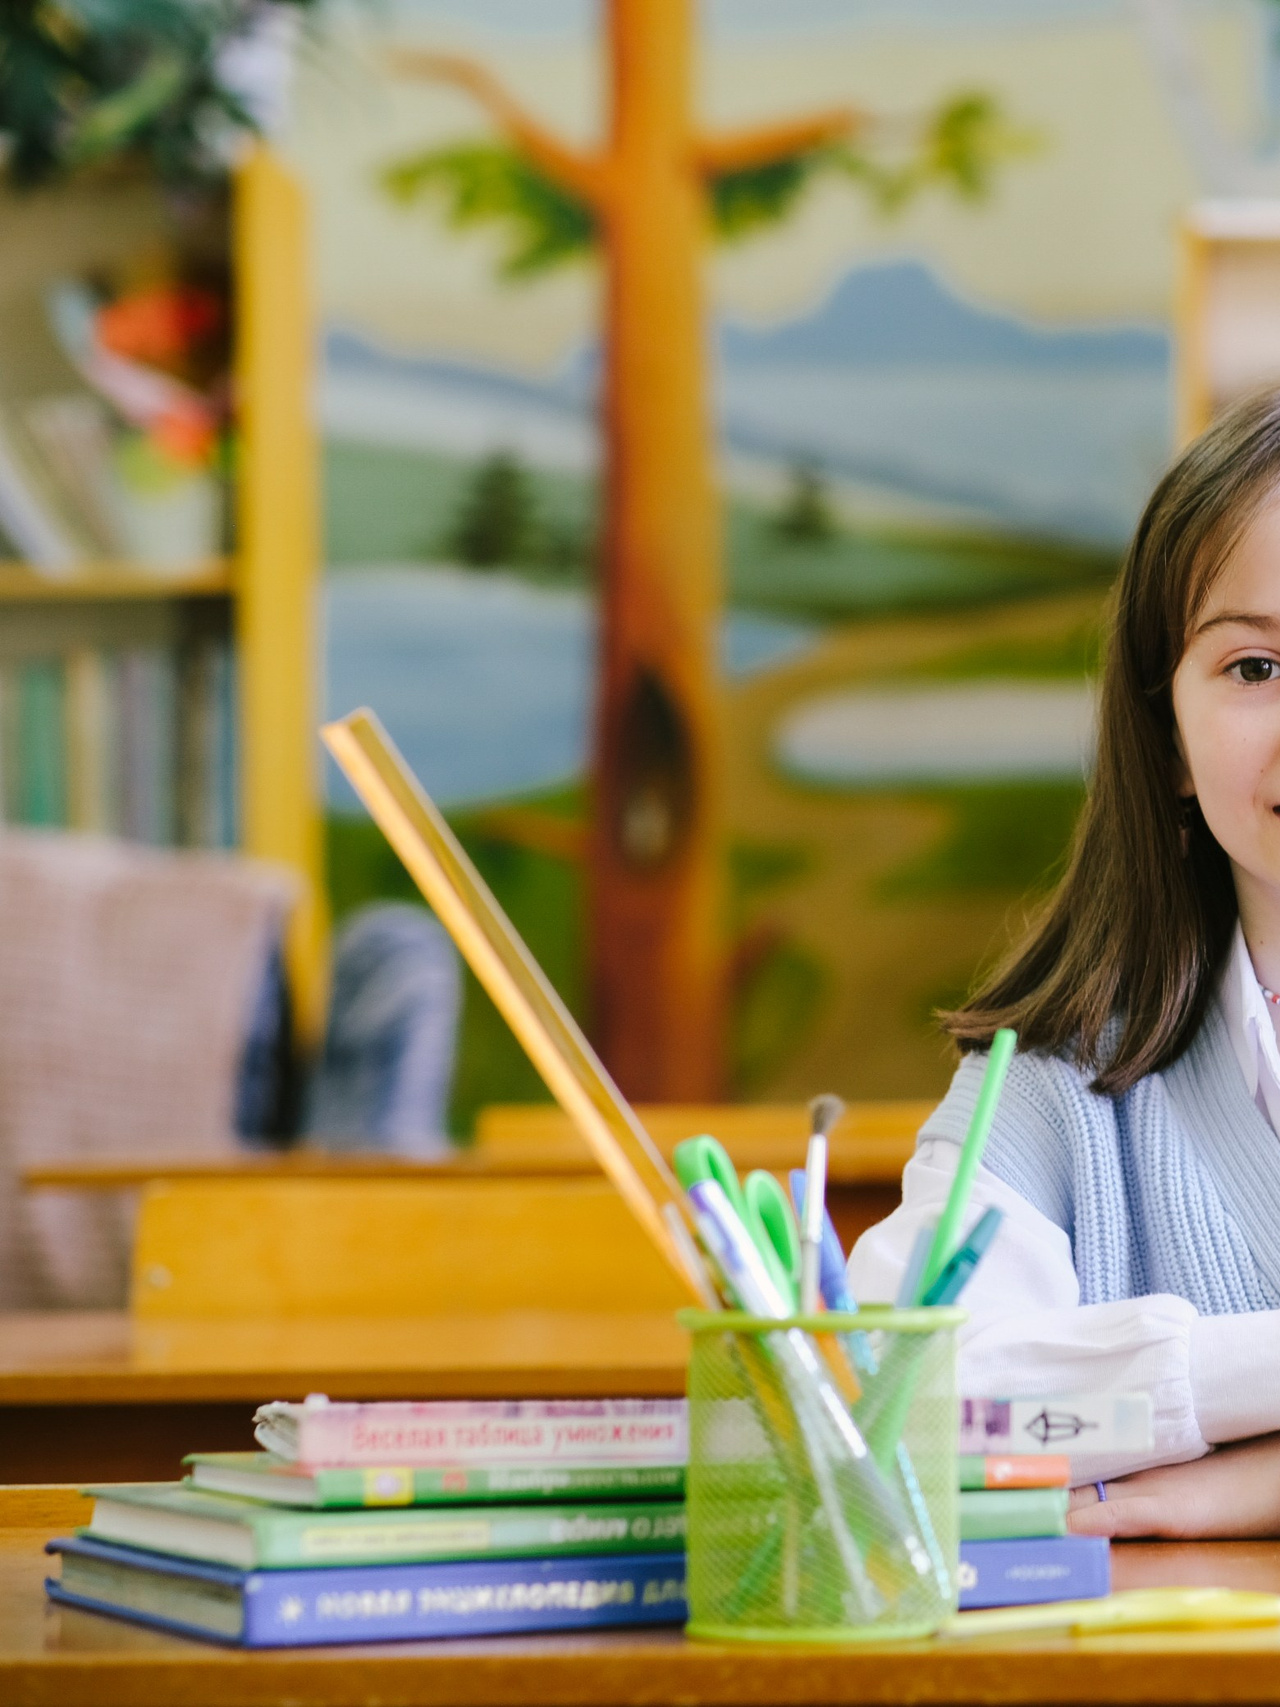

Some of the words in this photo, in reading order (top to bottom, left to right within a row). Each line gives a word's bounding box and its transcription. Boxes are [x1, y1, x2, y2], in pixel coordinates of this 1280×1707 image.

[455, 1420, 543, 1447] таблица
[552, 1423, 675, 1452] умножения
[316, 1589, 411, 1620] НОВАЯ
[417, 1580, 635, 1614] ЭНЦИКЛОПЕДИЯ
